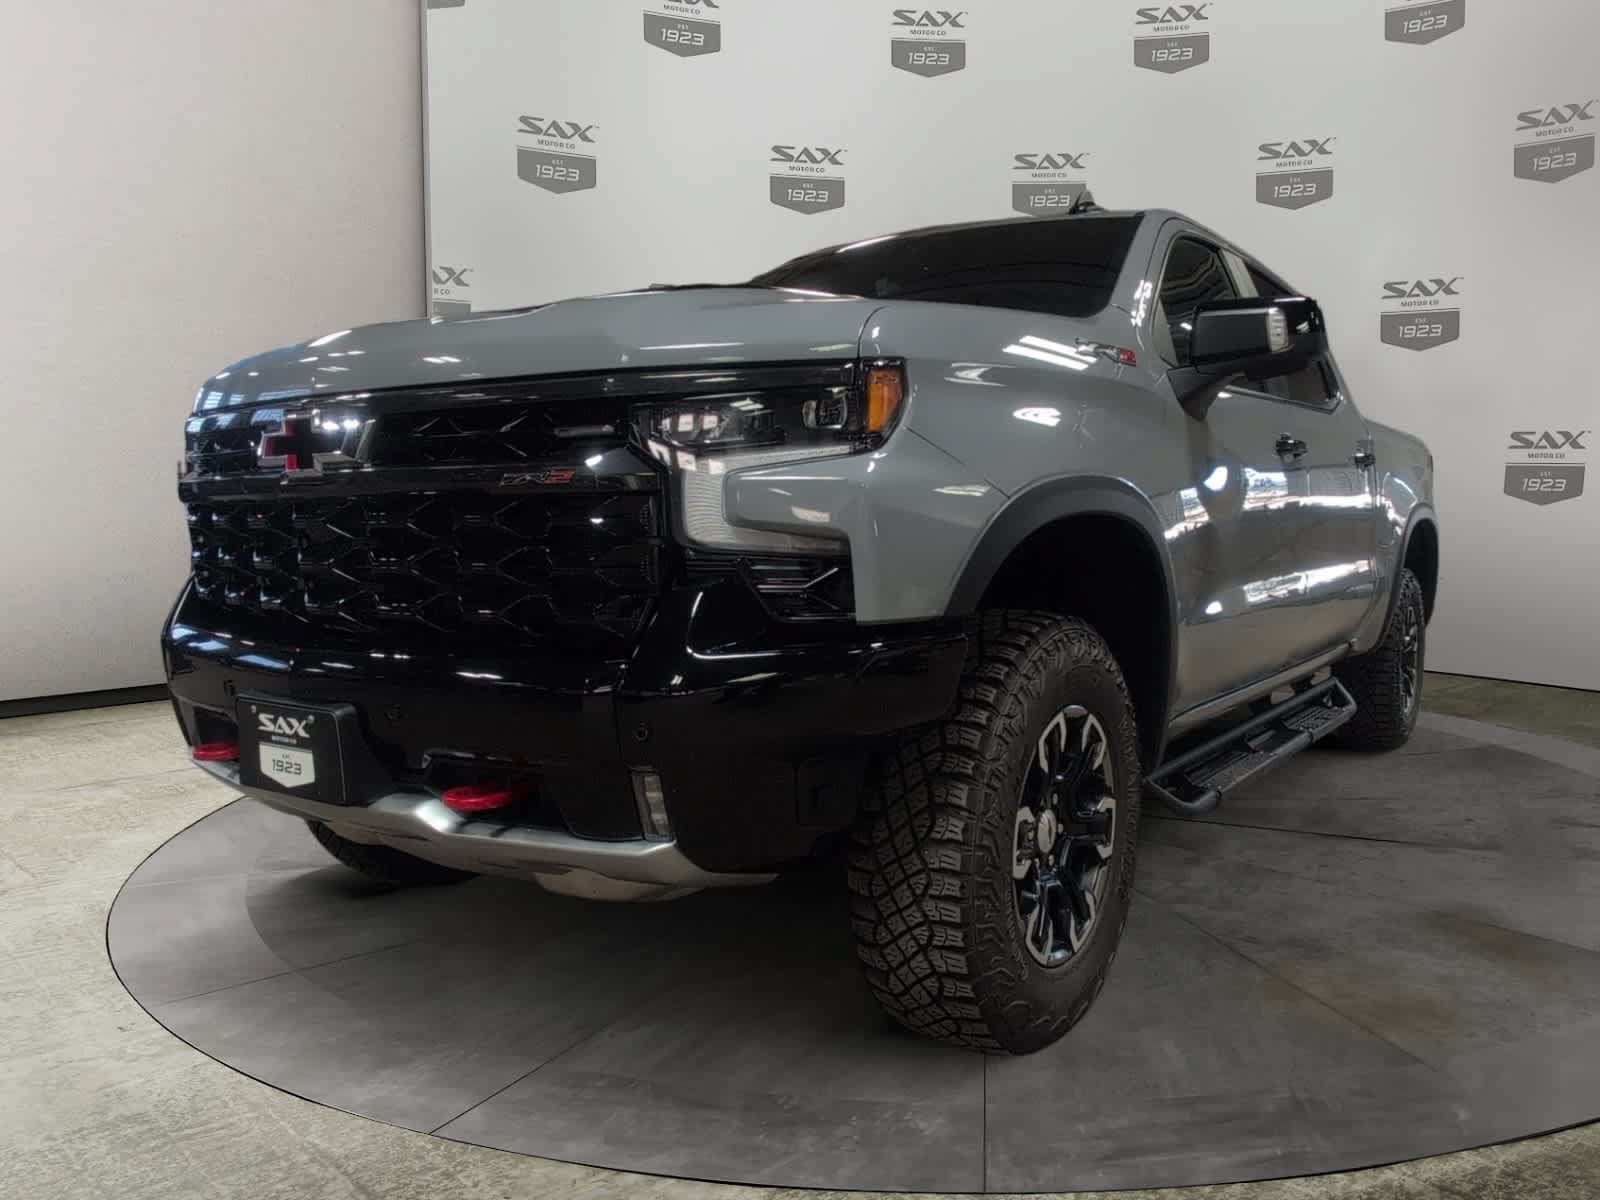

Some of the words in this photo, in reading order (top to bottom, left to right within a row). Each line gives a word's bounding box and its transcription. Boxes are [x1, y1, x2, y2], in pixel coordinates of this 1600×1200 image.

[892, 9, 965, 28] SAX
[1136, 3, 1208, 24] SAX
[1403, 14, 1447, 34] 1923
[661, 28, 704, 46] 1923
[908, 52, 949, 64] 1923
[1152, 47, 1193, 62] 1923
[1515, 99, 1594, 131] SAX
[517, 115, 595, 143] SAX
[771, 145, 844, 165] SAX
[1257, 137, 1332, 160] SAX
[1013, 153, 1086, 170] SAX
[1533, 152, 1576, 171] 1923
[536, 164, 579, 181] 1923
[787, 189, 829, 202] 1923
[1274, 183, 1316, 198] 1923
[1029, 195, 1070, 208] 1923
[1381, 277, 1460, 299] SAX
[1399, 324, 1442, 338] 1923
[1508, 430, 1586, 449] SAX
[1522, 478, 1566, 492] 1923
[257, 713, 311, 738] SAX
[271, 759, 302, 776] 1923
